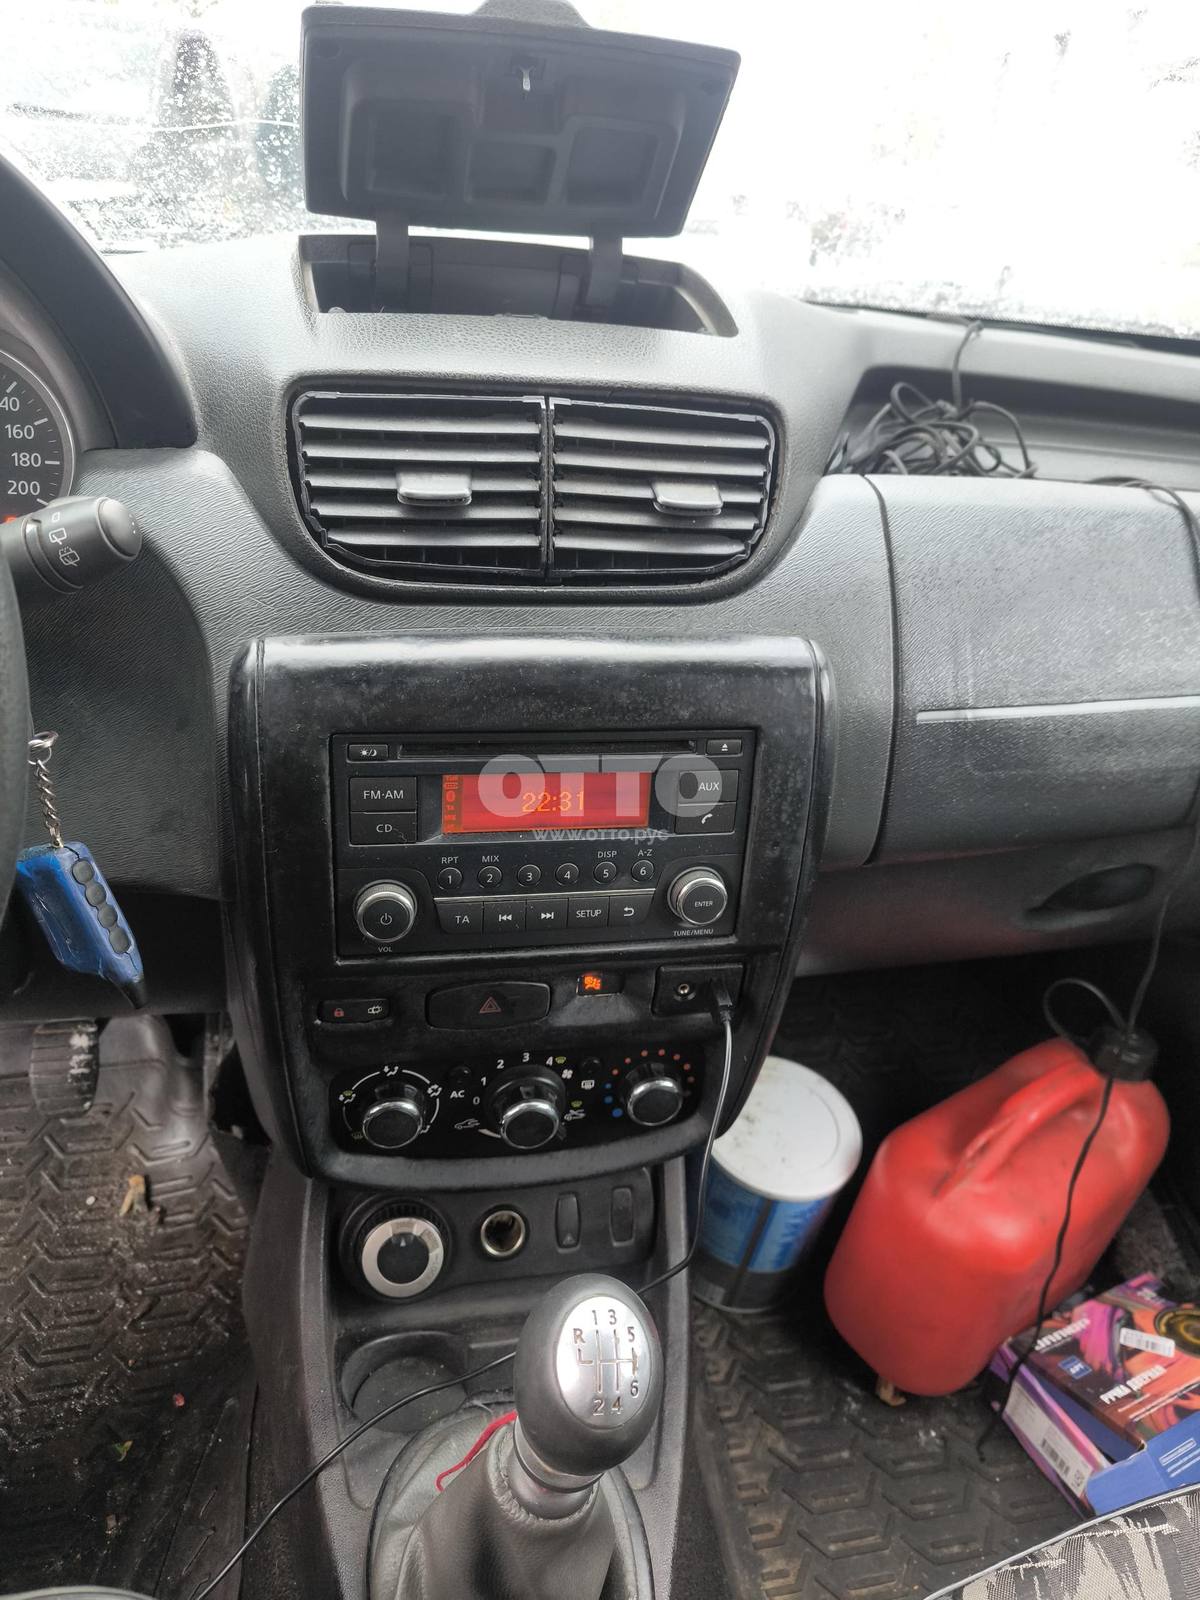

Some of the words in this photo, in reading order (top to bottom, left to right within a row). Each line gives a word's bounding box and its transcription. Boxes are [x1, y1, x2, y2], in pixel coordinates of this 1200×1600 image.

[0, 397, 20, 412] 40
[4, 424, 35, 440] 160
[11, 452, 42, 467] 180
[7, 480, 41, 495] 200
[698, 781, 720, 791] AUX
[522, 791, 584, 812] 22:31
[376, 823, 393, 833] CD
[597, 850, 618, 859] DISP
[637, 848, 653, 857] A-Z
[441, 856, 459, 864] RPT
[481, 855, 500, 863] MIX
[563, 870, 571, 880] 4
[602, 869, 609, 878] 5
[639, 866, 647, 876] 6
[447, 874, 453, 885] 1
[486, 873, 493, 883] 2
[526, 872, 533, 882] 3
[694, 900, 714, 908] ENTER
[576, 909, 602, 918] SETUP
[455, 915, 470, 924] TA
[673, 928, 714, 937] TUNE/MENU
[523, 1053, 530, 1062] 3
[545, 1056, 553, 1066] 4
[497, 1060, 504, 1069] 2
[481, 1077, 486, 1086] 1
[450, 1089, 465, 1099] AC
[473, 1097, 480, 1105] 0
[592, 1310, 598, 1325] 1
[608, 1309, 617, 1325] 3
[572, 1328, 586, 1345] R
[626, 1326, 636, 1343] 5
[630, 1379, 639, 1398] 6
[592, 1399, 605, 1416] 2
[610, 1396, 623, 1415] 4
